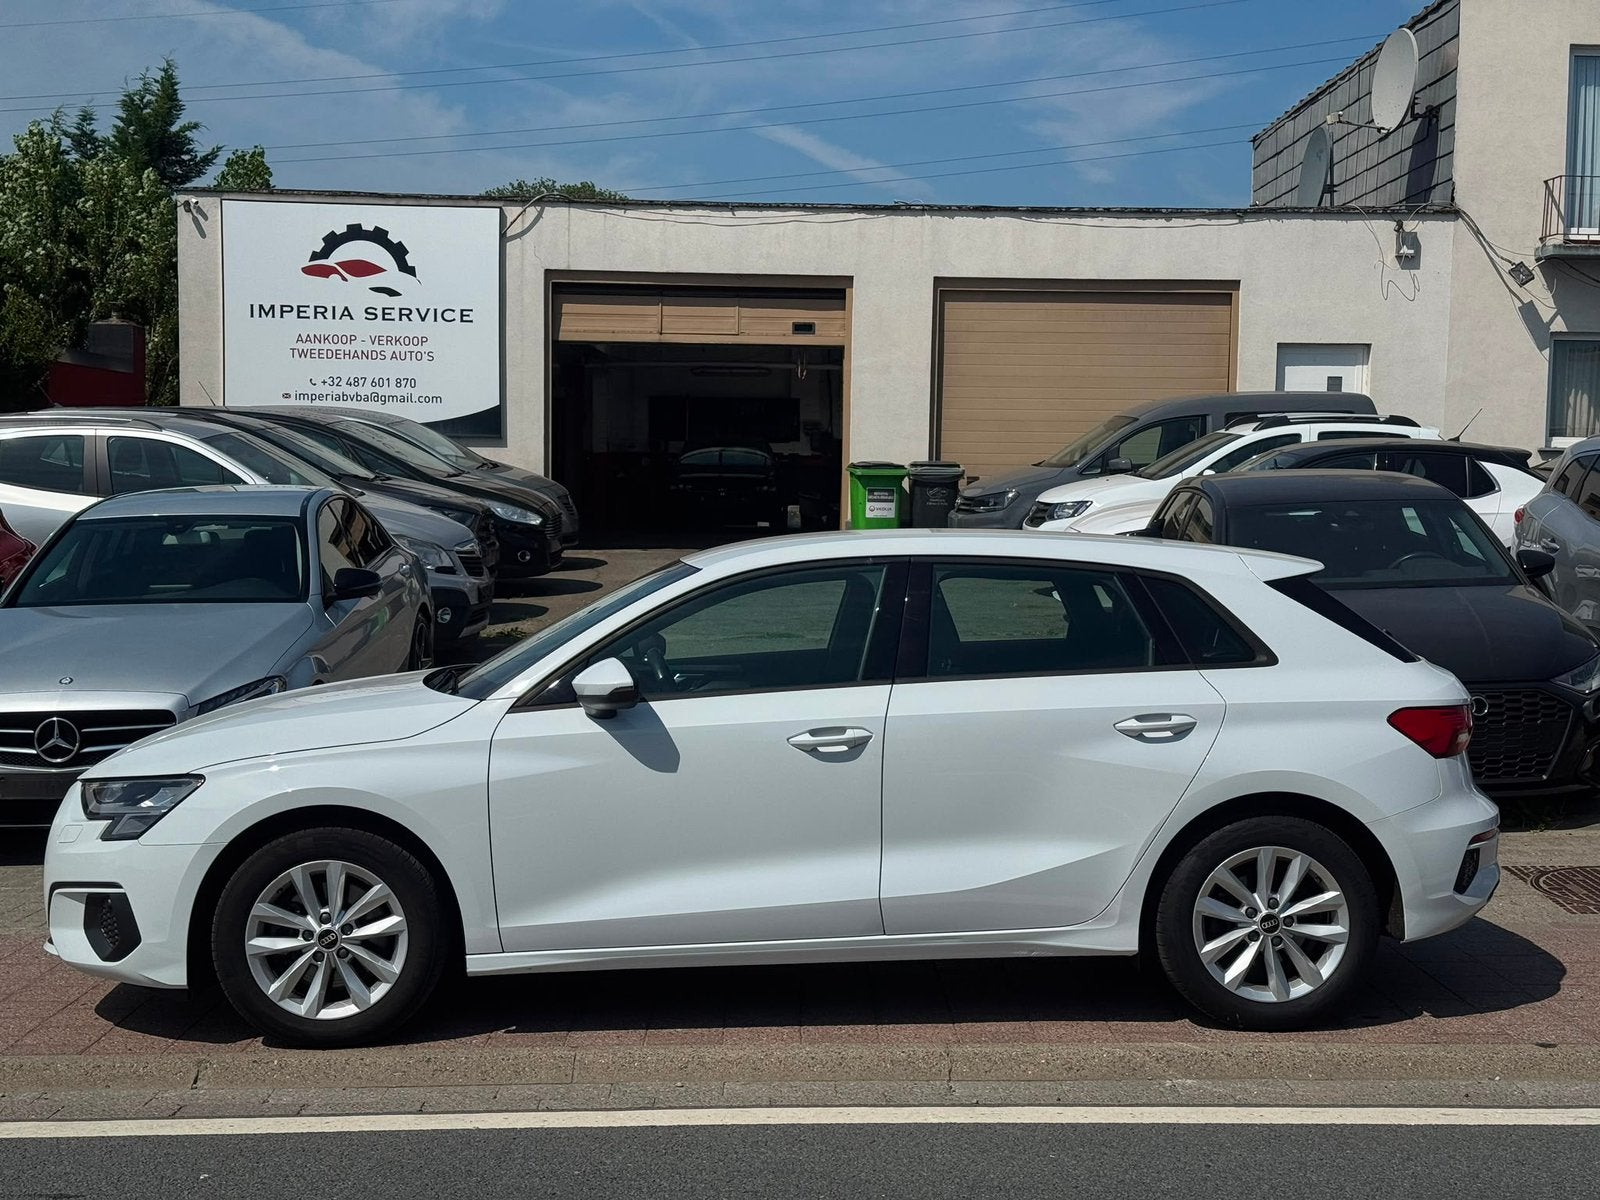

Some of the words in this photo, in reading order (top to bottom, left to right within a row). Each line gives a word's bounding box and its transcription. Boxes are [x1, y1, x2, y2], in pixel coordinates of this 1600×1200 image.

[249, 303, 355, 320] IMPERIA
[364, 306, 474, 323] SERVICE
[295, 332, 358, 346] AANKOOP
[368, 334, 429, 347] VERKOOP
[289, 347, 387, 361] TWEEDEHANDS
[389, 350, 435, 362] AUTO'S
[320, 375, 343, 388] +32
[345, 376, 368, 388] 487
[370, 376, 391, 389] 601
[394, 377, 417, 389] 870
[294, 389, 443, 406] imperiabvba@gmail.com
